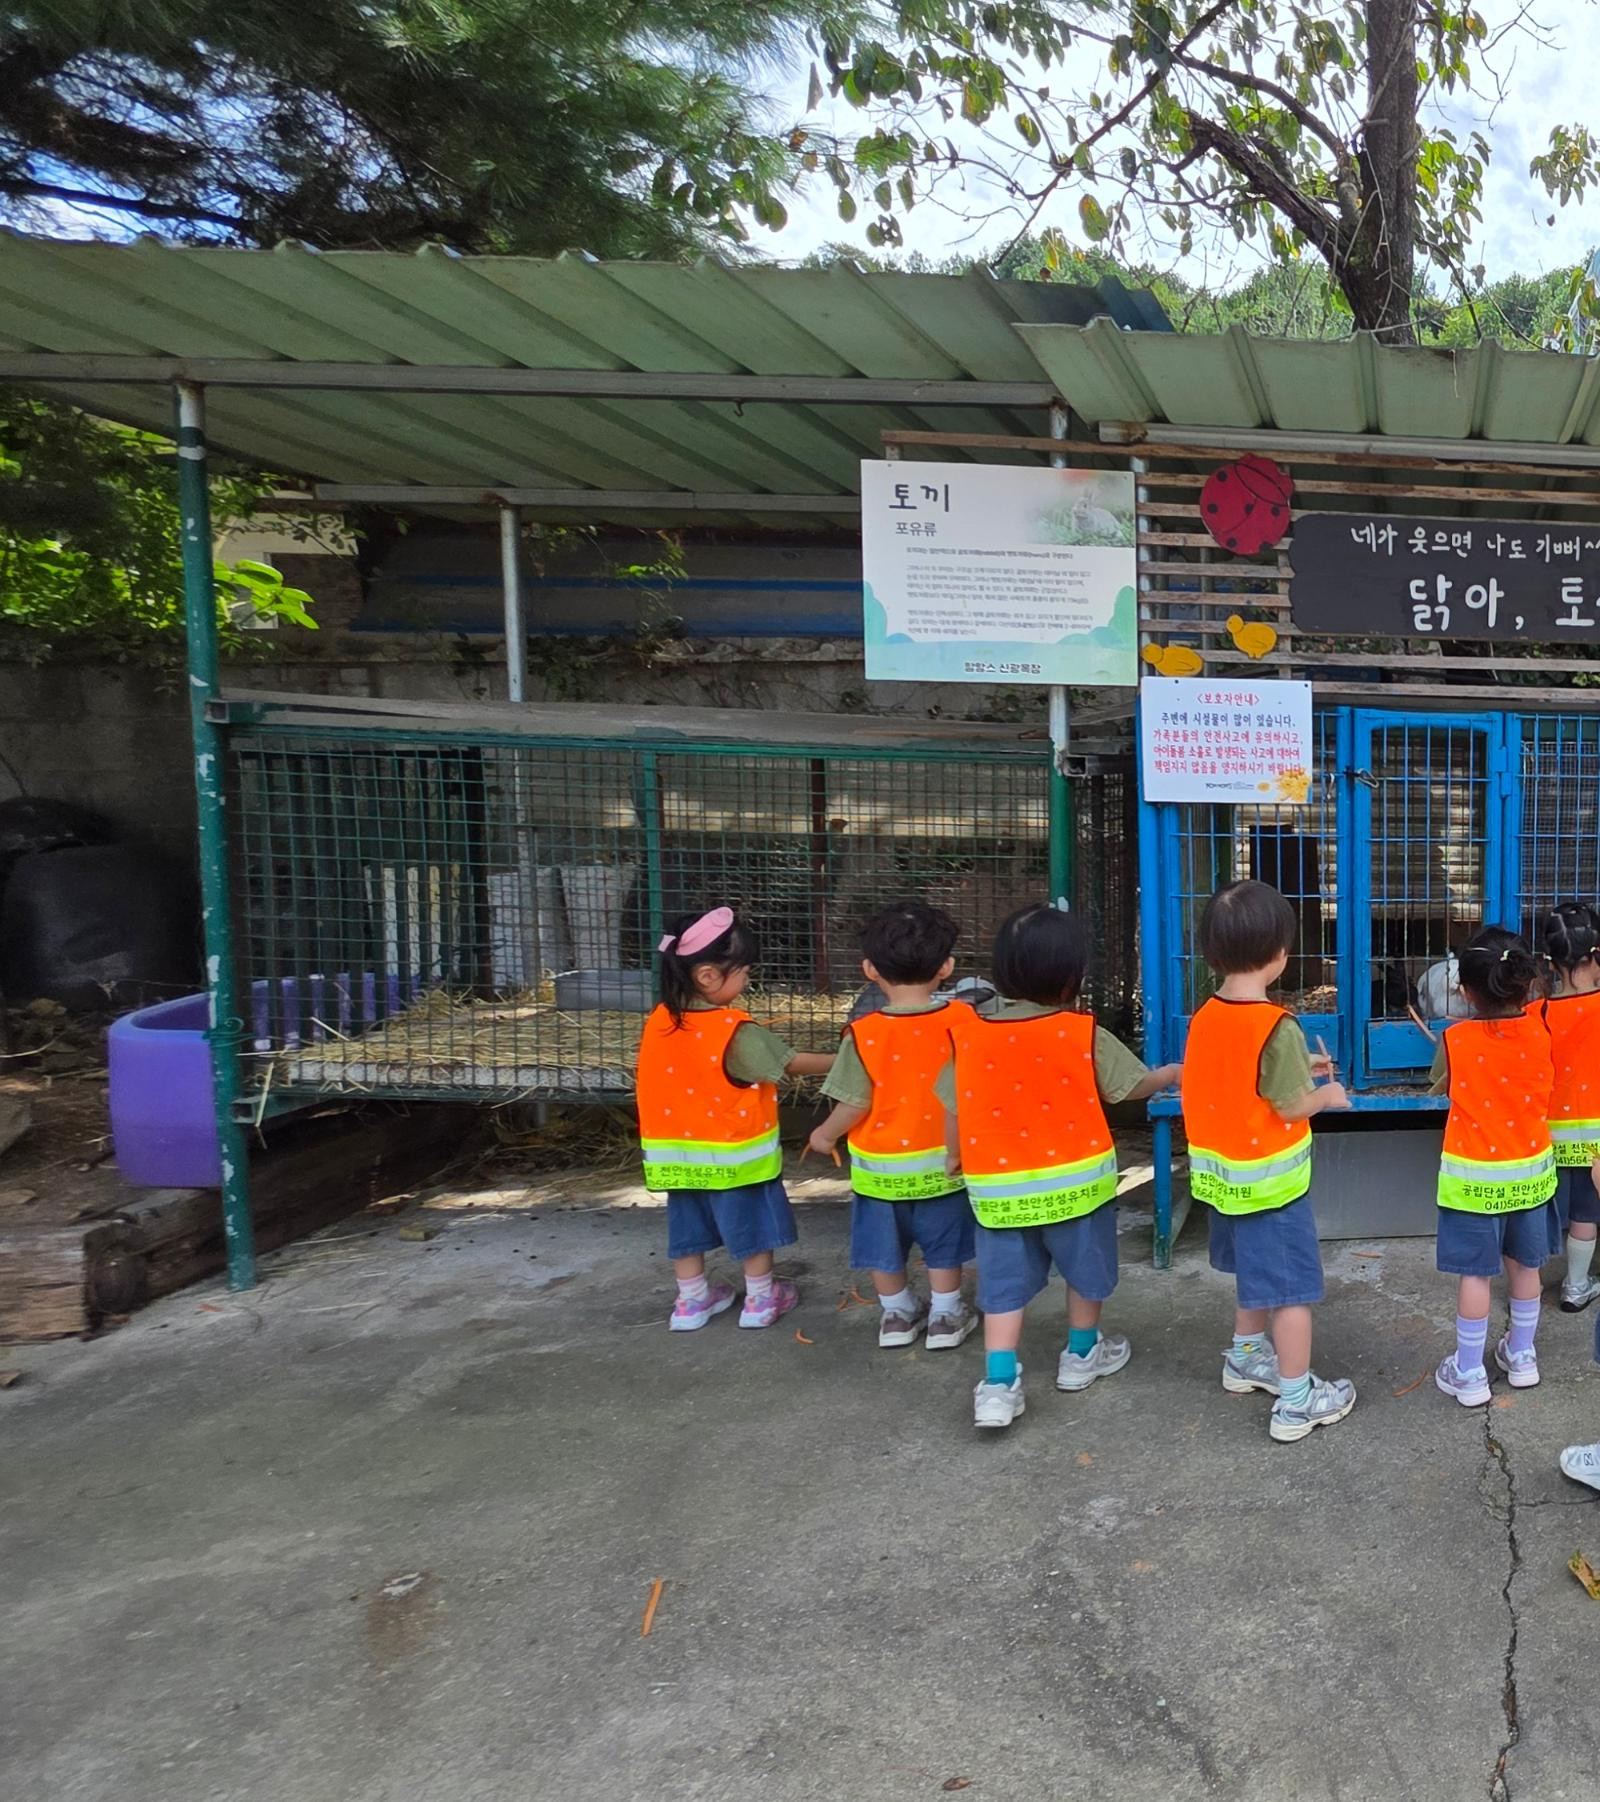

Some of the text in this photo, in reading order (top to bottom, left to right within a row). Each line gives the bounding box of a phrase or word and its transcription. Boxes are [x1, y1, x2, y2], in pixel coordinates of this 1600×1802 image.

[889, 483, 949, 512] 토끼
[895, 522, 937, 537] 포유류
[1351, 522, 1398, 556] 네가
[1408, 526, 1472, 557] 웃으면
[1487, 534, 1526, 559] 나도
[1161, 712, 1188, 726] 주변에
[1193, 712, 1229, 727] 시설물이
[1234, 713, 1250, 727] 많이
[1204, 730, 1249, 744] 안전사고에
[1251, 746, 1274, 760] 사고에
[1462, 1184, 1506, 1199] 공립단설
